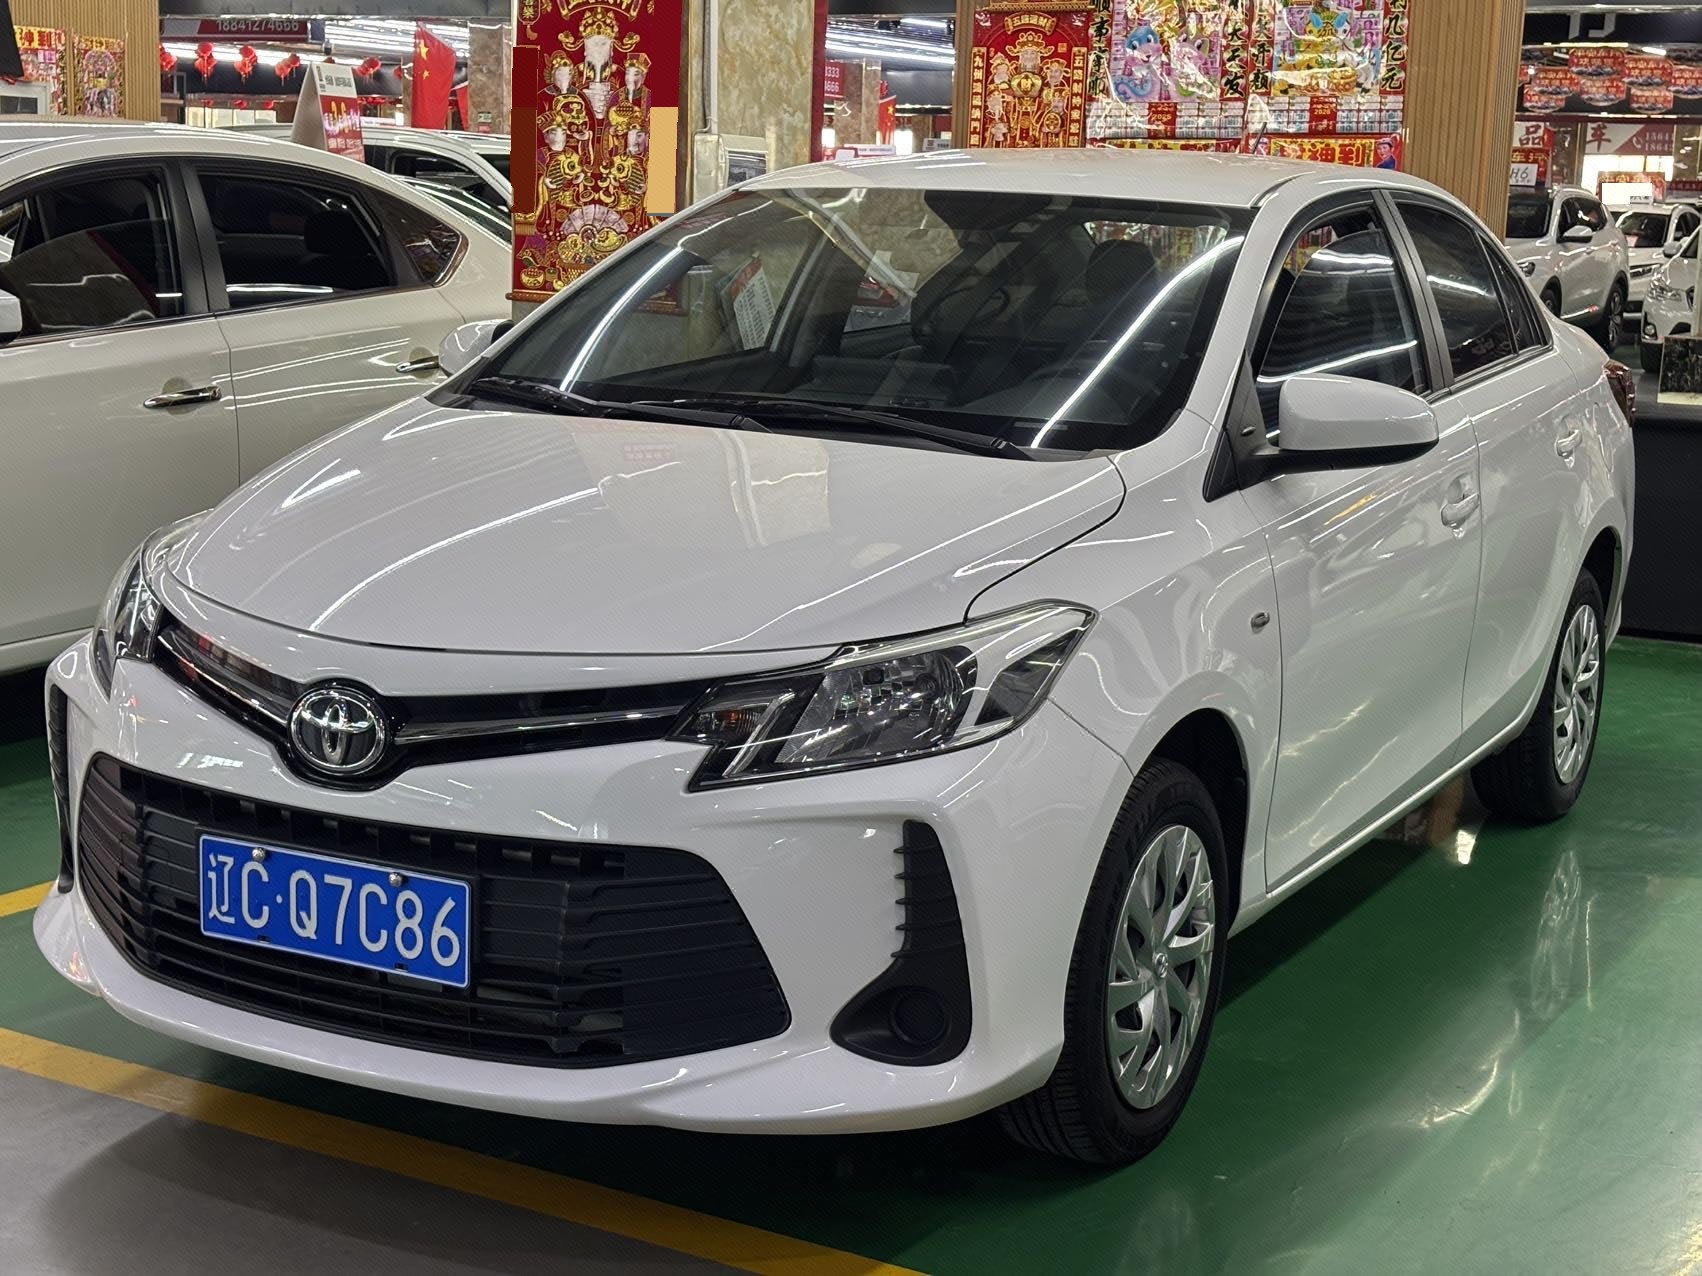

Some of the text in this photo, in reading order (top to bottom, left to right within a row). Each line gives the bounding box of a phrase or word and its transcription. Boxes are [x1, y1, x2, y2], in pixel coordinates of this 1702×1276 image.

[1518, 124, 1543, 146] 品
[1586, 122, 1612, 152] 车
[208, 853, 460, 968] 辽C·Q7C86
